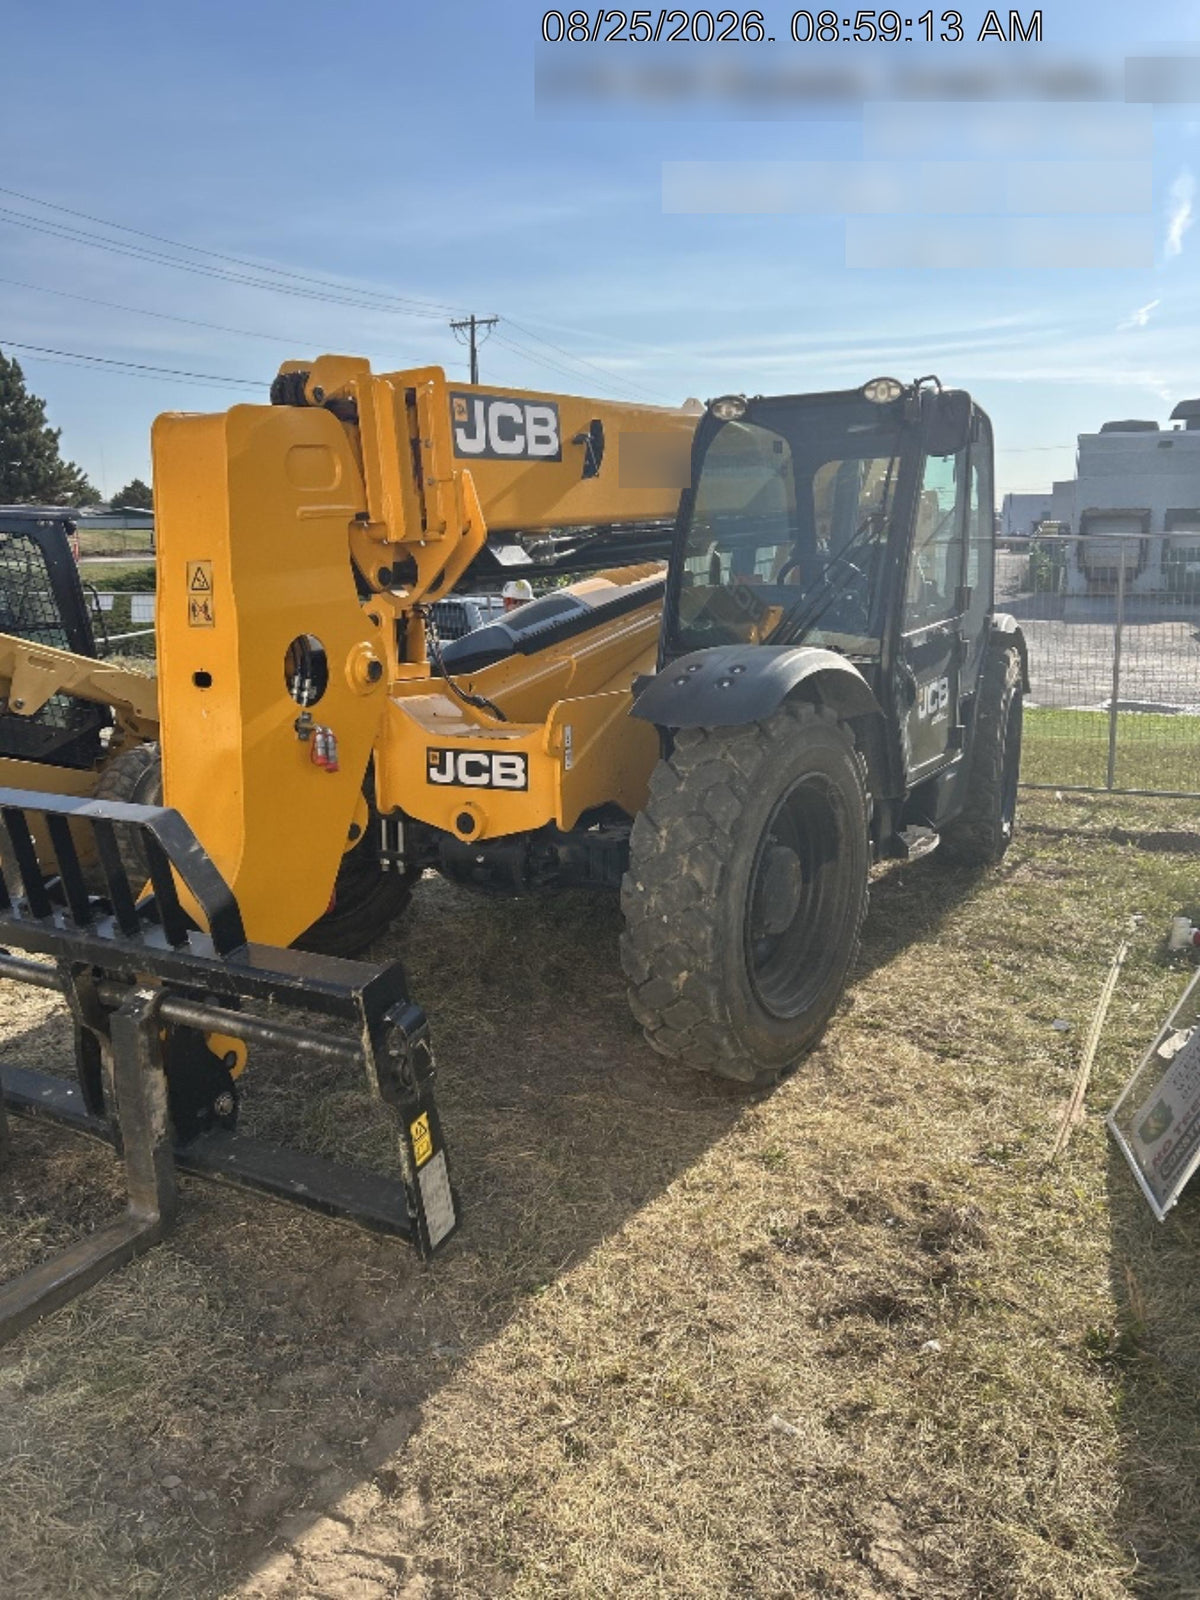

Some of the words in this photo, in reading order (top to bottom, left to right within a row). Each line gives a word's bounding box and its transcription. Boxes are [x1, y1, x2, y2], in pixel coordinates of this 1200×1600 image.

[455, 399, 559, 456] JCB
[918, 677, 949, 719] JCB
[429, 751, 526, 788] JCB
